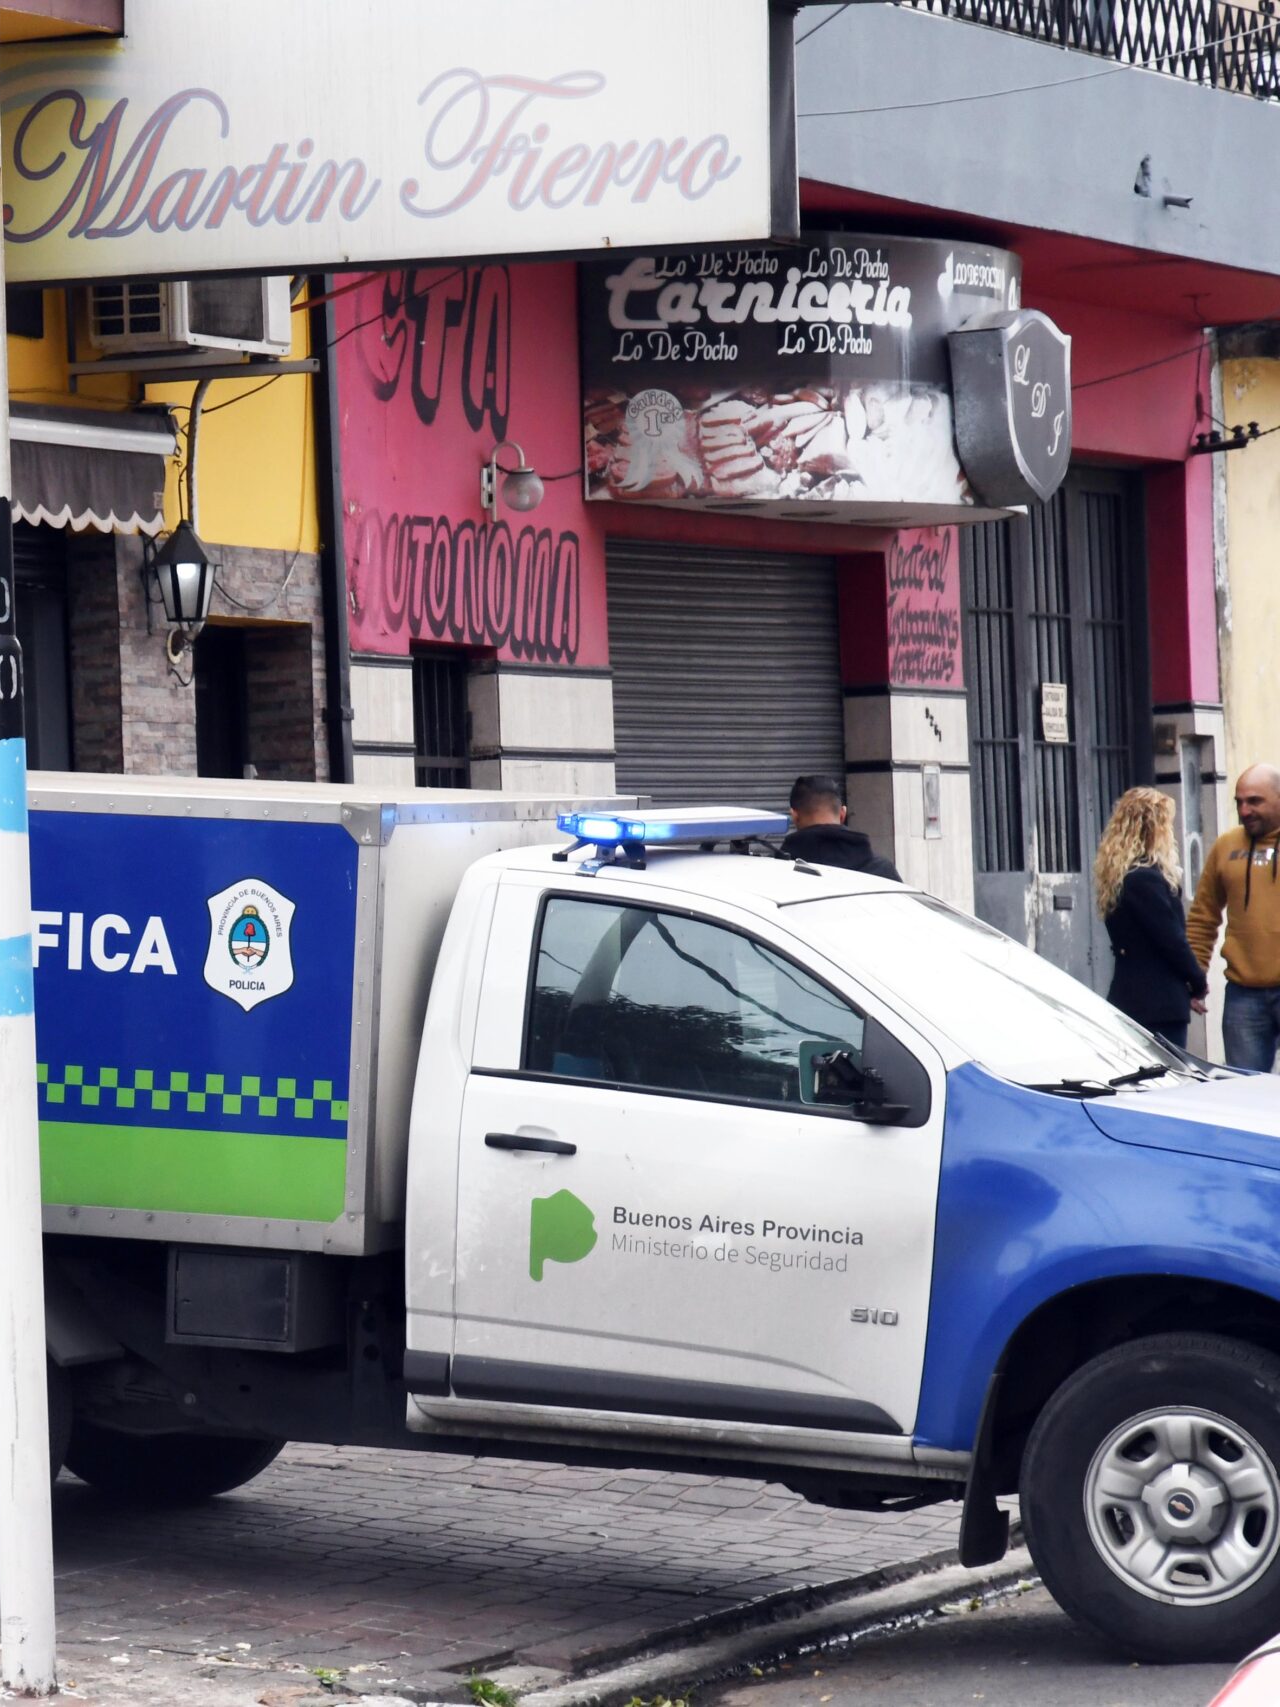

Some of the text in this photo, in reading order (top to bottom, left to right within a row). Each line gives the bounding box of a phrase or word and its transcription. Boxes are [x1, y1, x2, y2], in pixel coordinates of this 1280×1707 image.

[401, 67, 742, 218] Fierro
[802, 247, 889, 279] Lo De Pocho
[612, 331, 738, 362] Lo De Pocho
[778, 323, 873, 355] Lo De Pocho
[218, 888, 283, 938] PROVINCIA DE BUENOS AIRES
[229, 979, 266, 991] POLICIA
[613, 1206, 864, 1246] Buenos Aires Provincia
[612, 1233, 848, 1272] Ministerio de Seguridad
[849, 1306, 899, 1327] S10
